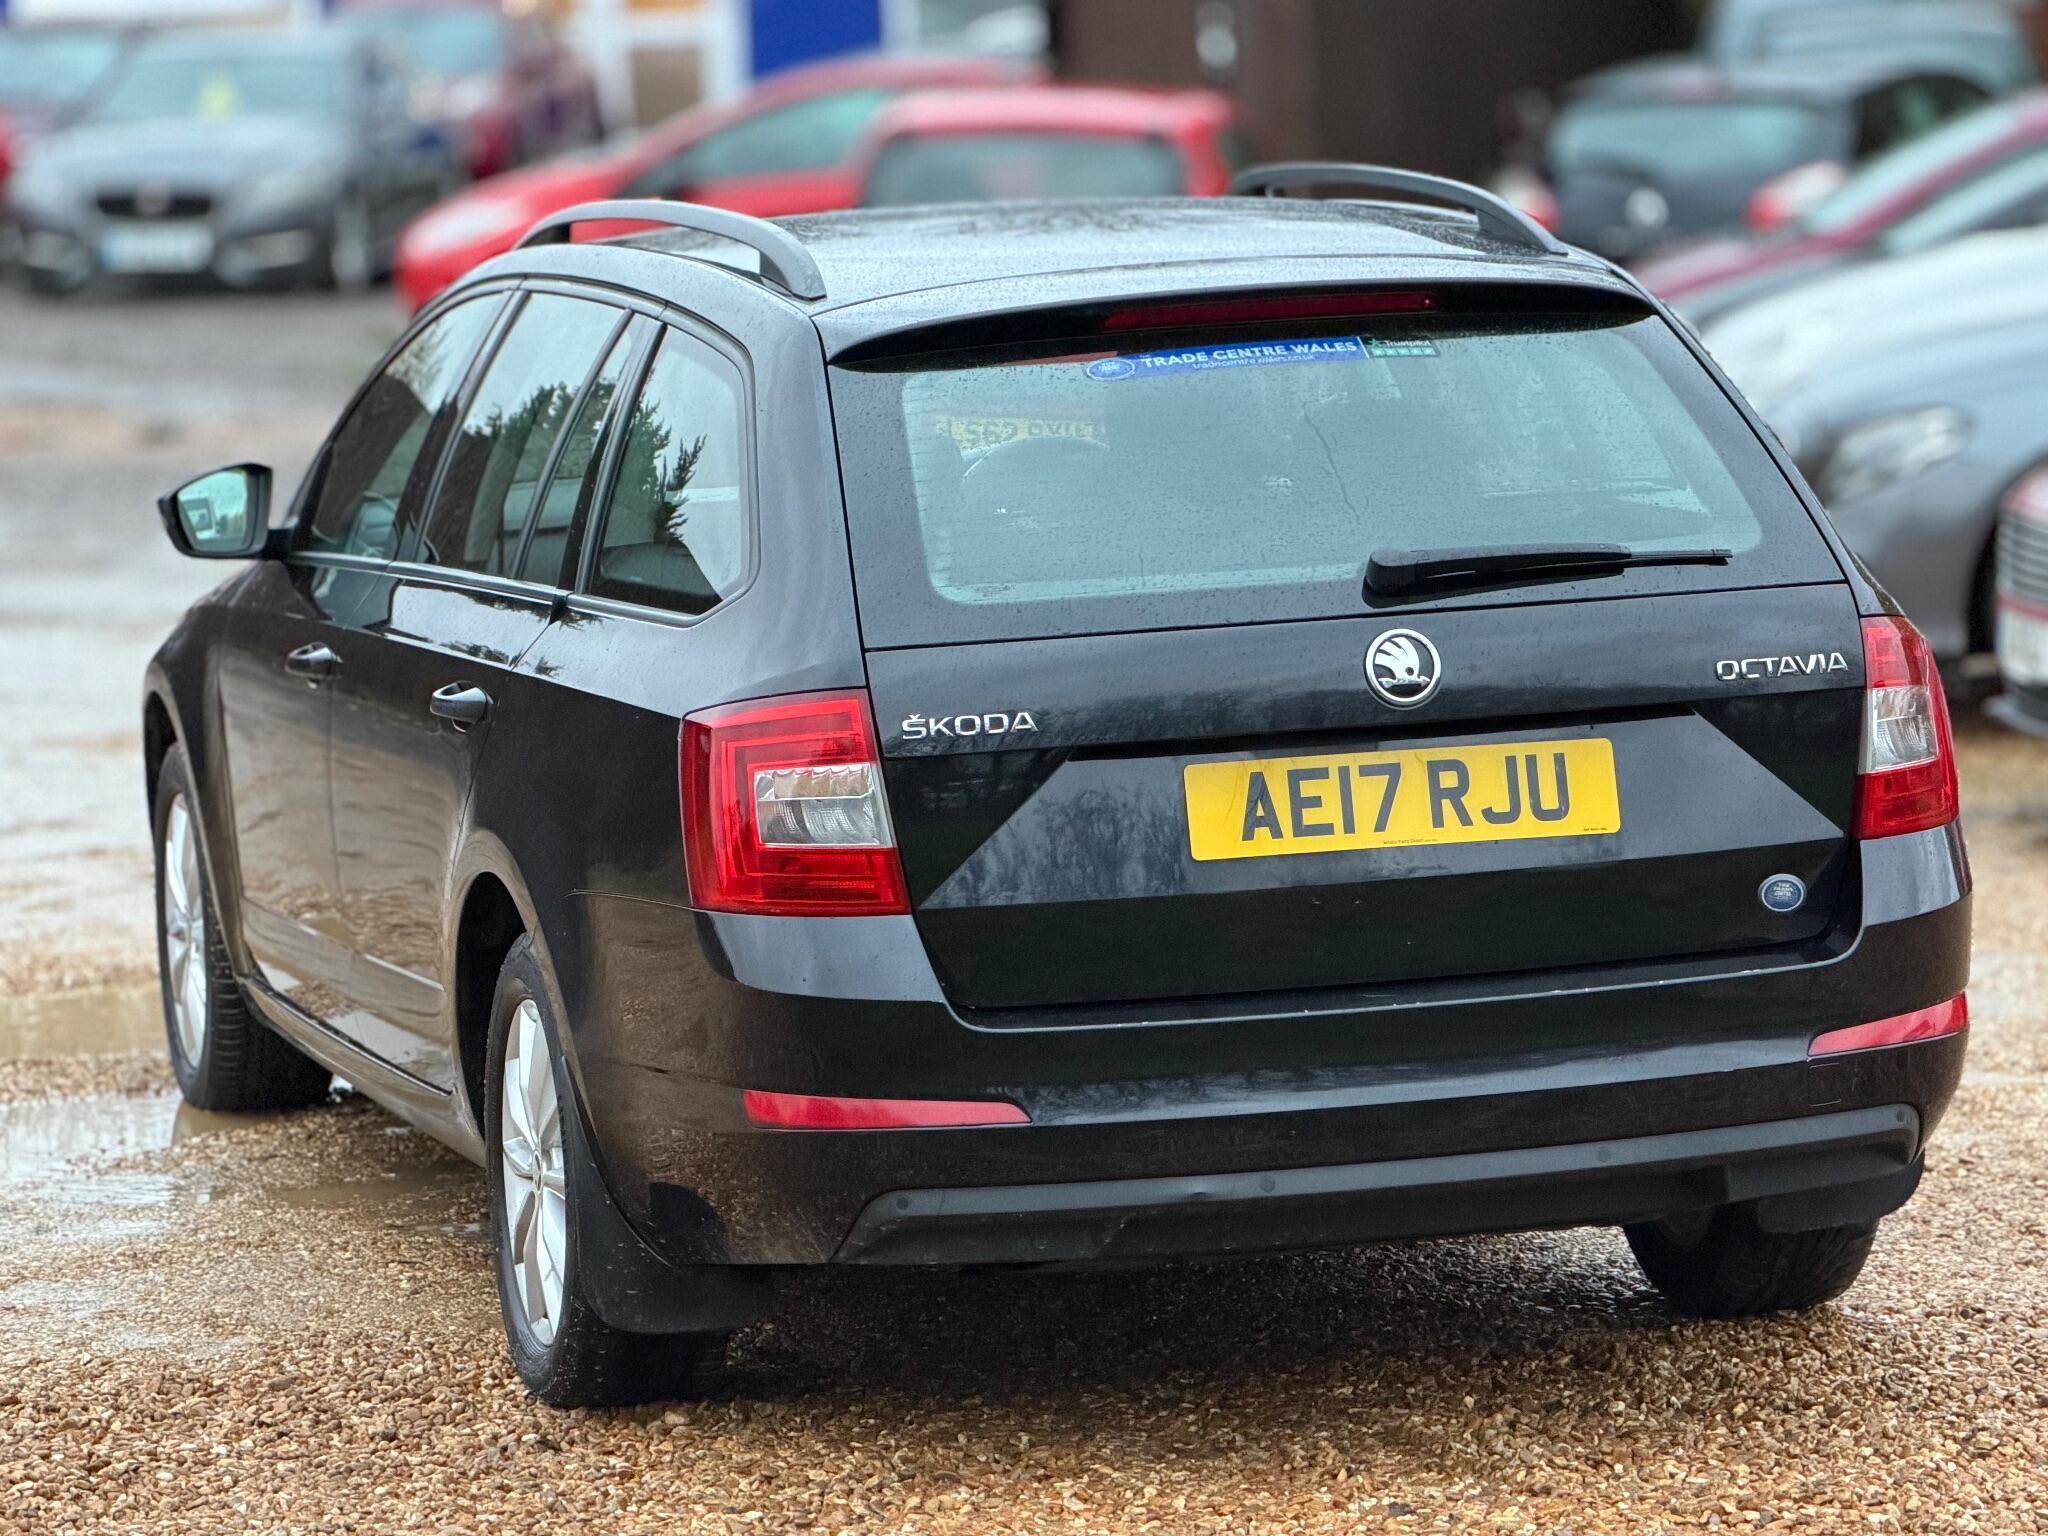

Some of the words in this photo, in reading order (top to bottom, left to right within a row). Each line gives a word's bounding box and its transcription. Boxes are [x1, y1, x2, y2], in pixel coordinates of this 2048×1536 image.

[1141, 351, 1209, 368] TRADE
[1212, 344, 1288, 361] CENTRE
[1289, 341, 1358, 354] WALES
[1716, 652, 1849, 681] OCTAVIA
[902, 711, 1039, 740] ŠKODA
[1242, 762, 1402, 841] AE17
[1426, 752, 1570, 829] RJU
